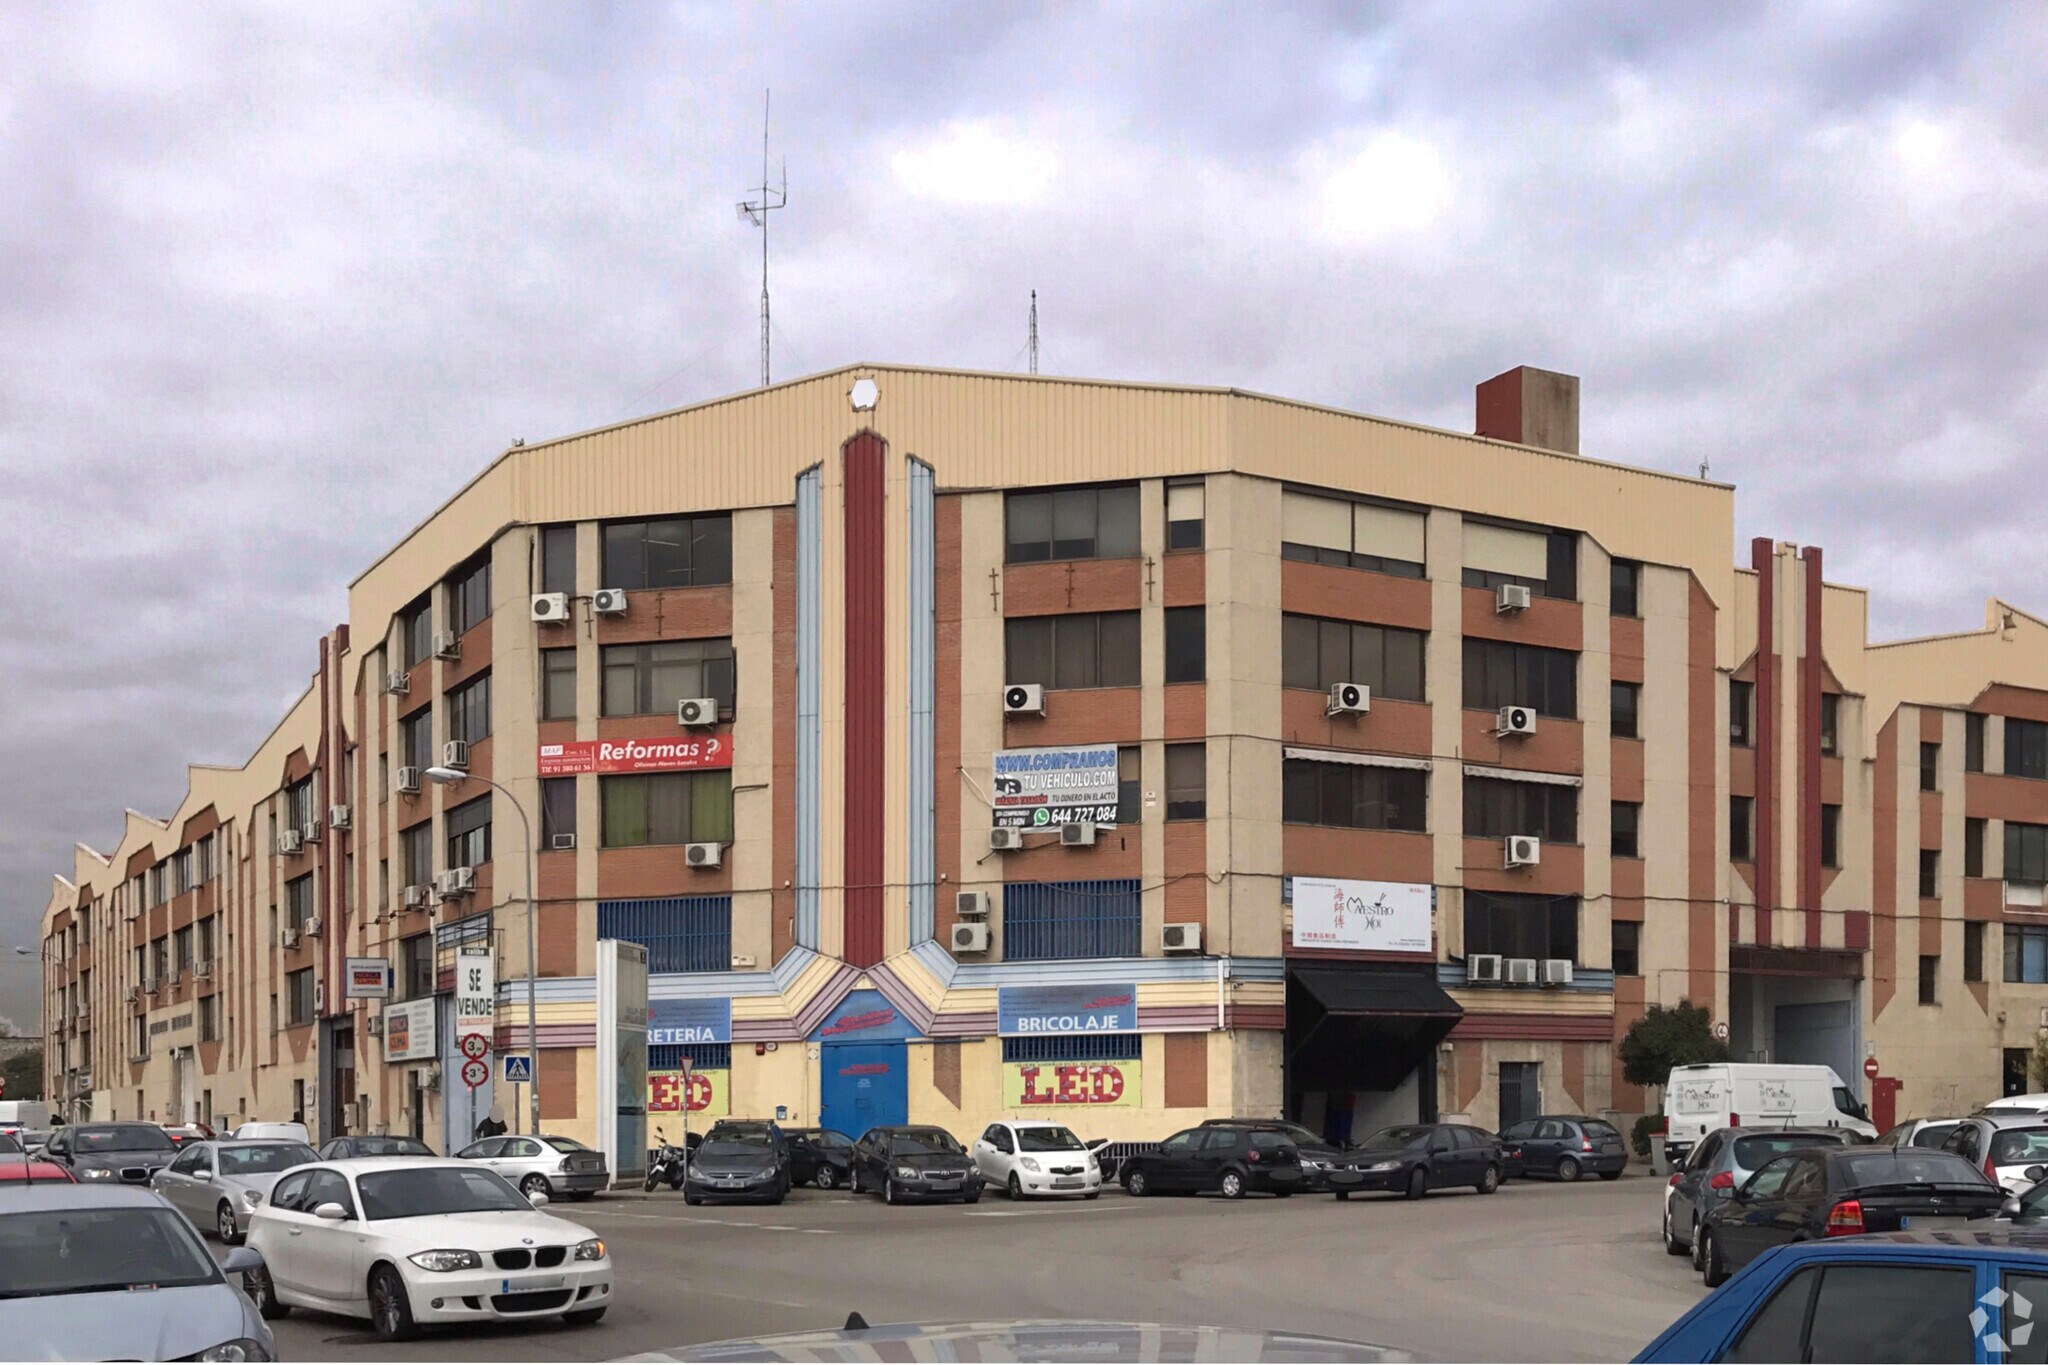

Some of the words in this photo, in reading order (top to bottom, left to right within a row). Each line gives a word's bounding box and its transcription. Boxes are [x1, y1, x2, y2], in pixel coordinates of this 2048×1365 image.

[600, 740, 699, 761] Reformas
[995, 749, 1116, 773] WWW.COMPRAMOS
[1024, 774, 1037, 790] TU
[1041, 770, 1116, 789] VEHICULO.COM
[1052, 794, 1059, 802] TU
[1061, 793, 1083, 802] DINERO
[1083, 793, 1092, 801] EN
[1092, 793, 1099, 801] EL
[1099, 791, 1116, 800] ACTO
[1051, 808, 1071, 824] 644
[1074, 807, 1094, 823] 727
[1096, 805, 1117, 822] 084
[469, 968, 482, 992] SE
[458, 998, 493, 1016] VENDE
[1017, 1014, 1119, 1032] BRICOLAJE
[467, 1041, 475, 1052] 3
[469, 1068, 477, 1078] 3
[1020, 1065, 1125, 1105] LED
